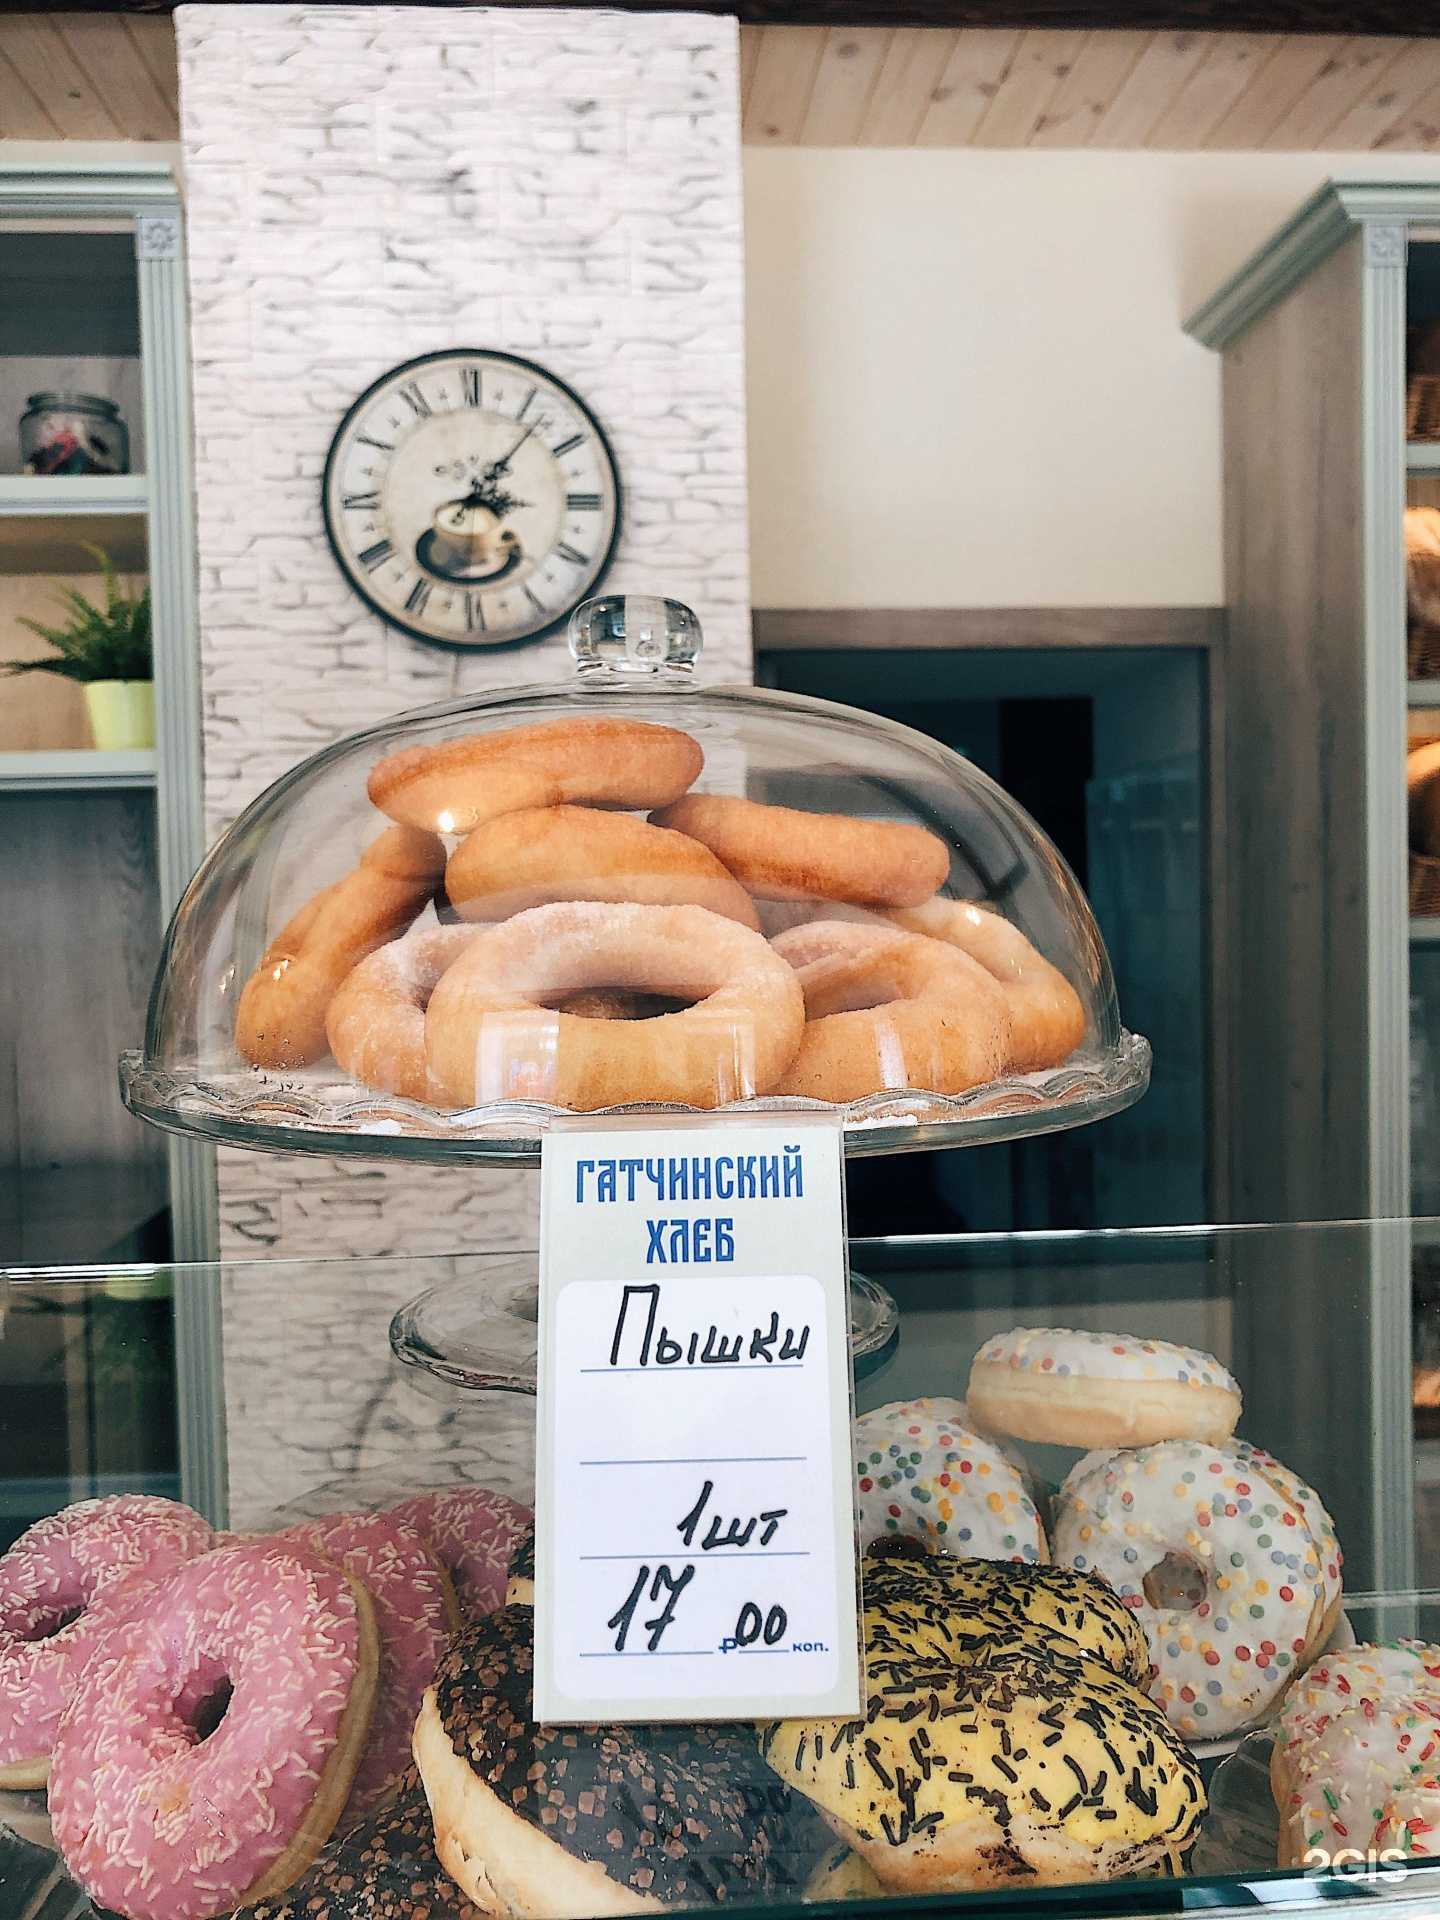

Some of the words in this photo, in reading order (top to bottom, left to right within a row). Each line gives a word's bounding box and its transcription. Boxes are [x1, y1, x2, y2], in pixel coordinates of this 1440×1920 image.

[575, 1144, 804, 1203] ГАТЧИНСКИЙ
[645, 1217, 736, 1264] ХЛЕБ
[609, 1283, 810, 1367] Пышки
[607, 1564, 696, 1652] 17
[735, 1601, 788, 1647] 00
[792, 1641, 830, 1653] коп.
